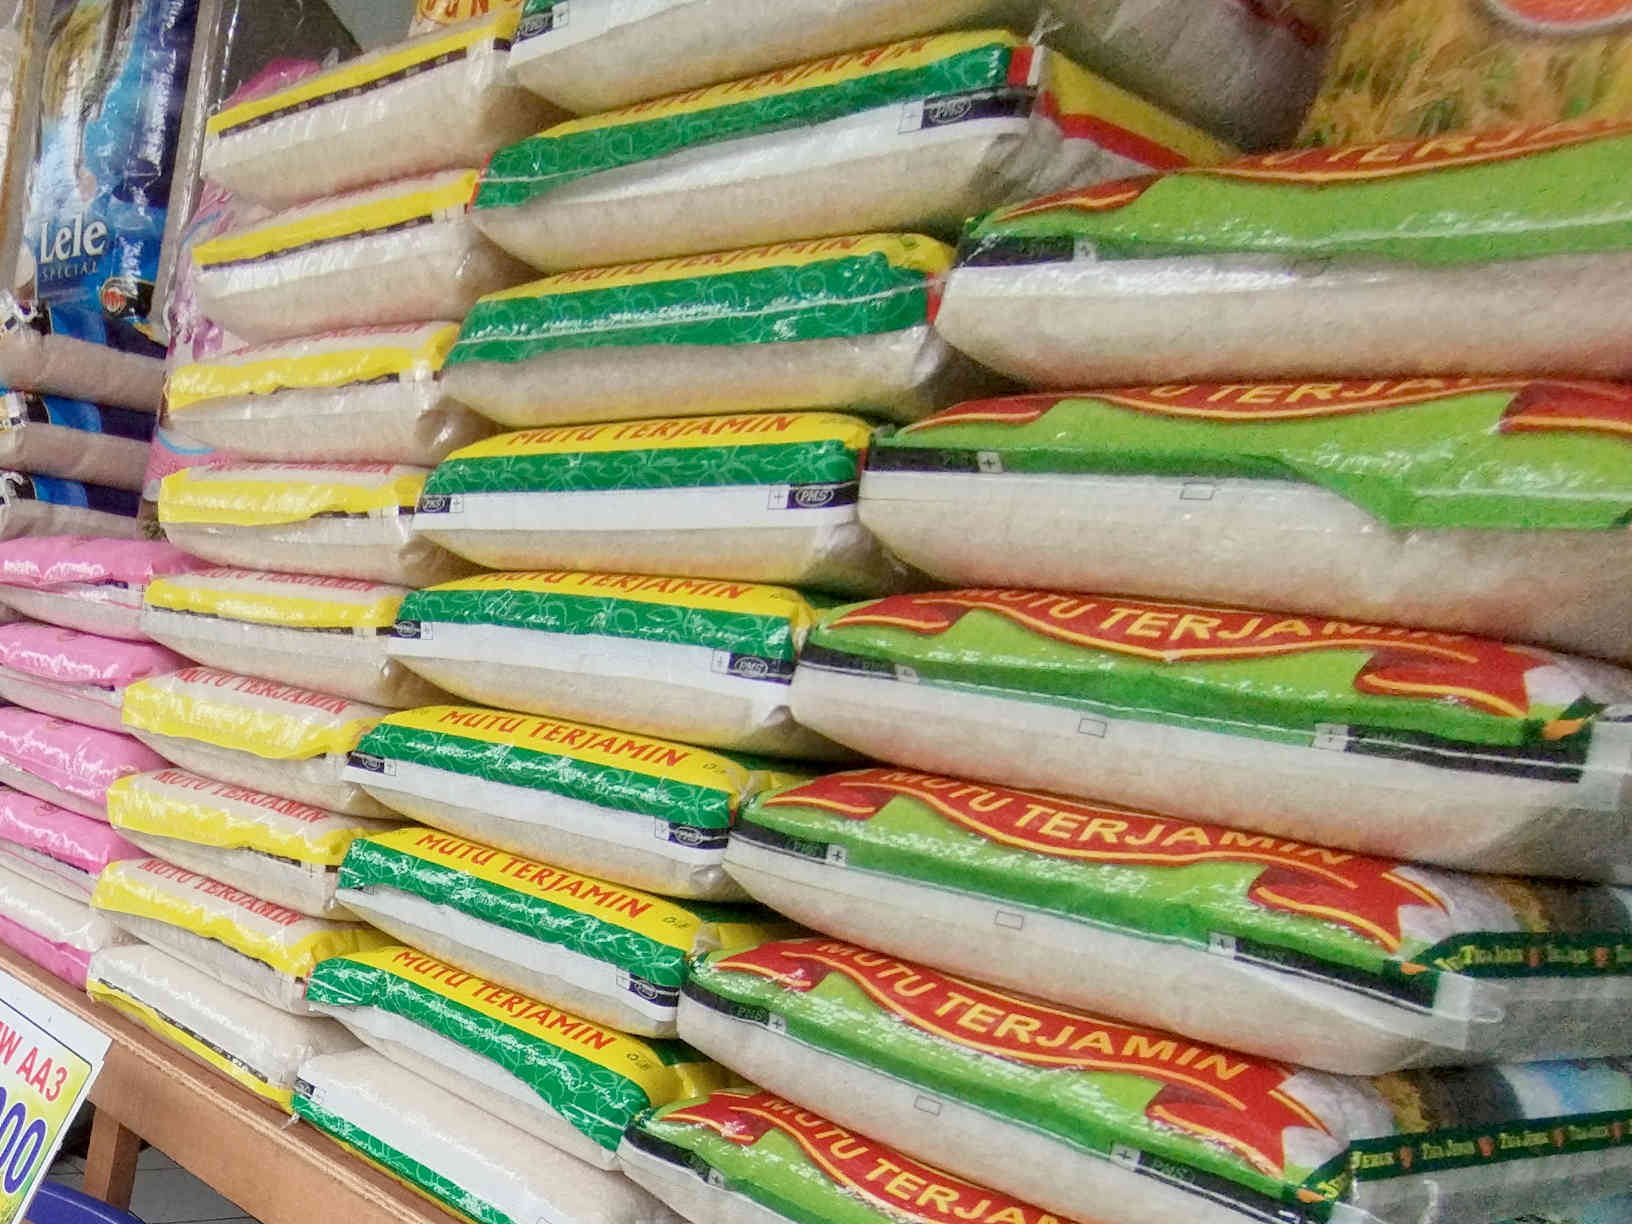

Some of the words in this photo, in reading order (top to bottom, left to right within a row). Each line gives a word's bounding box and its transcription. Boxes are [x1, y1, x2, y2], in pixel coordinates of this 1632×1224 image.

[39, 211, 109, 264] Lele
[41, 261, 98, 281] SPECIAL
[506, 426, 609, 446] MUTU
[613, 415, 808, 441] TERJAMIN
[799, 487, 829, 502] PMS
[576, 573, 754, 599] TERJAMIN
[1098, 606, 1468, 642] TERJAM
[232, 675, 352, 716] TERJAMIN
[438, 710, 526, 734] MUTU
[528, 720, 690, 767] TERJAMIN
[152, 770, 211, 792] MUTU
[211, 782, 330, 824] TERJAMIN
[879, 770, 1013, 812] MUTU
[1011, 803, 1353, 867] TERJAMIN
[135, 858, 195, 885] MUTU
[192, 875, 305, 926] TERJAMIN
[415, 833, 496, 866] MUTU
[500, 855, 654, 920] TERJAMIN
[391, 949, 470, 987] MUTU
[470, 977, 619, 1051] TERJAMIN
[816, 941, 936, 999] MUTU
[931, 990, 1252, 1082] TERJAMIN
[16, 1046, 68, 1103] AA3
[762, 1099, 870, 1161] MUTU
